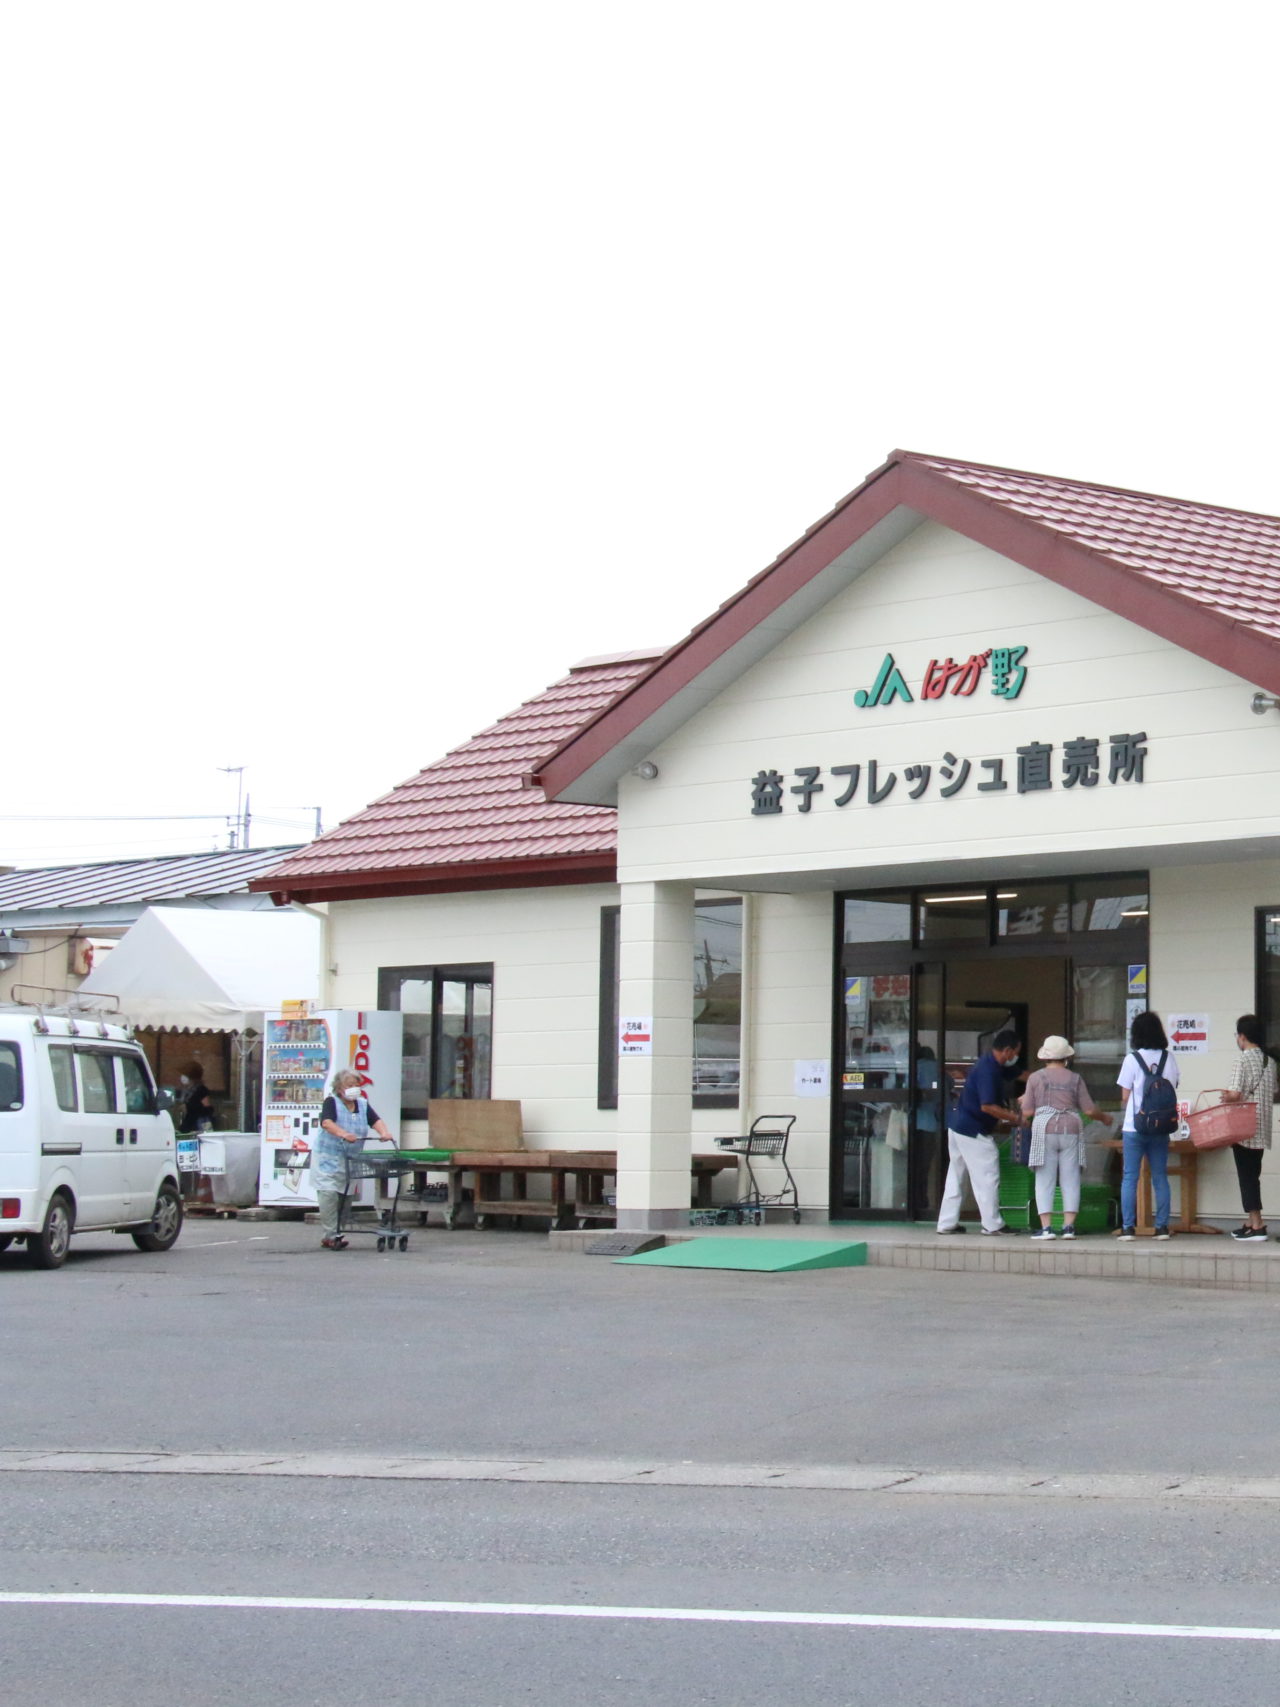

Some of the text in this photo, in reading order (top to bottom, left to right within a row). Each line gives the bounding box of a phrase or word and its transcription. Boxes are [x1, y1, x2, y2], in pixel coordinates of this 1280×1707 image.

[751, 732, 1148, 815] 益子フレッシュ直売所
